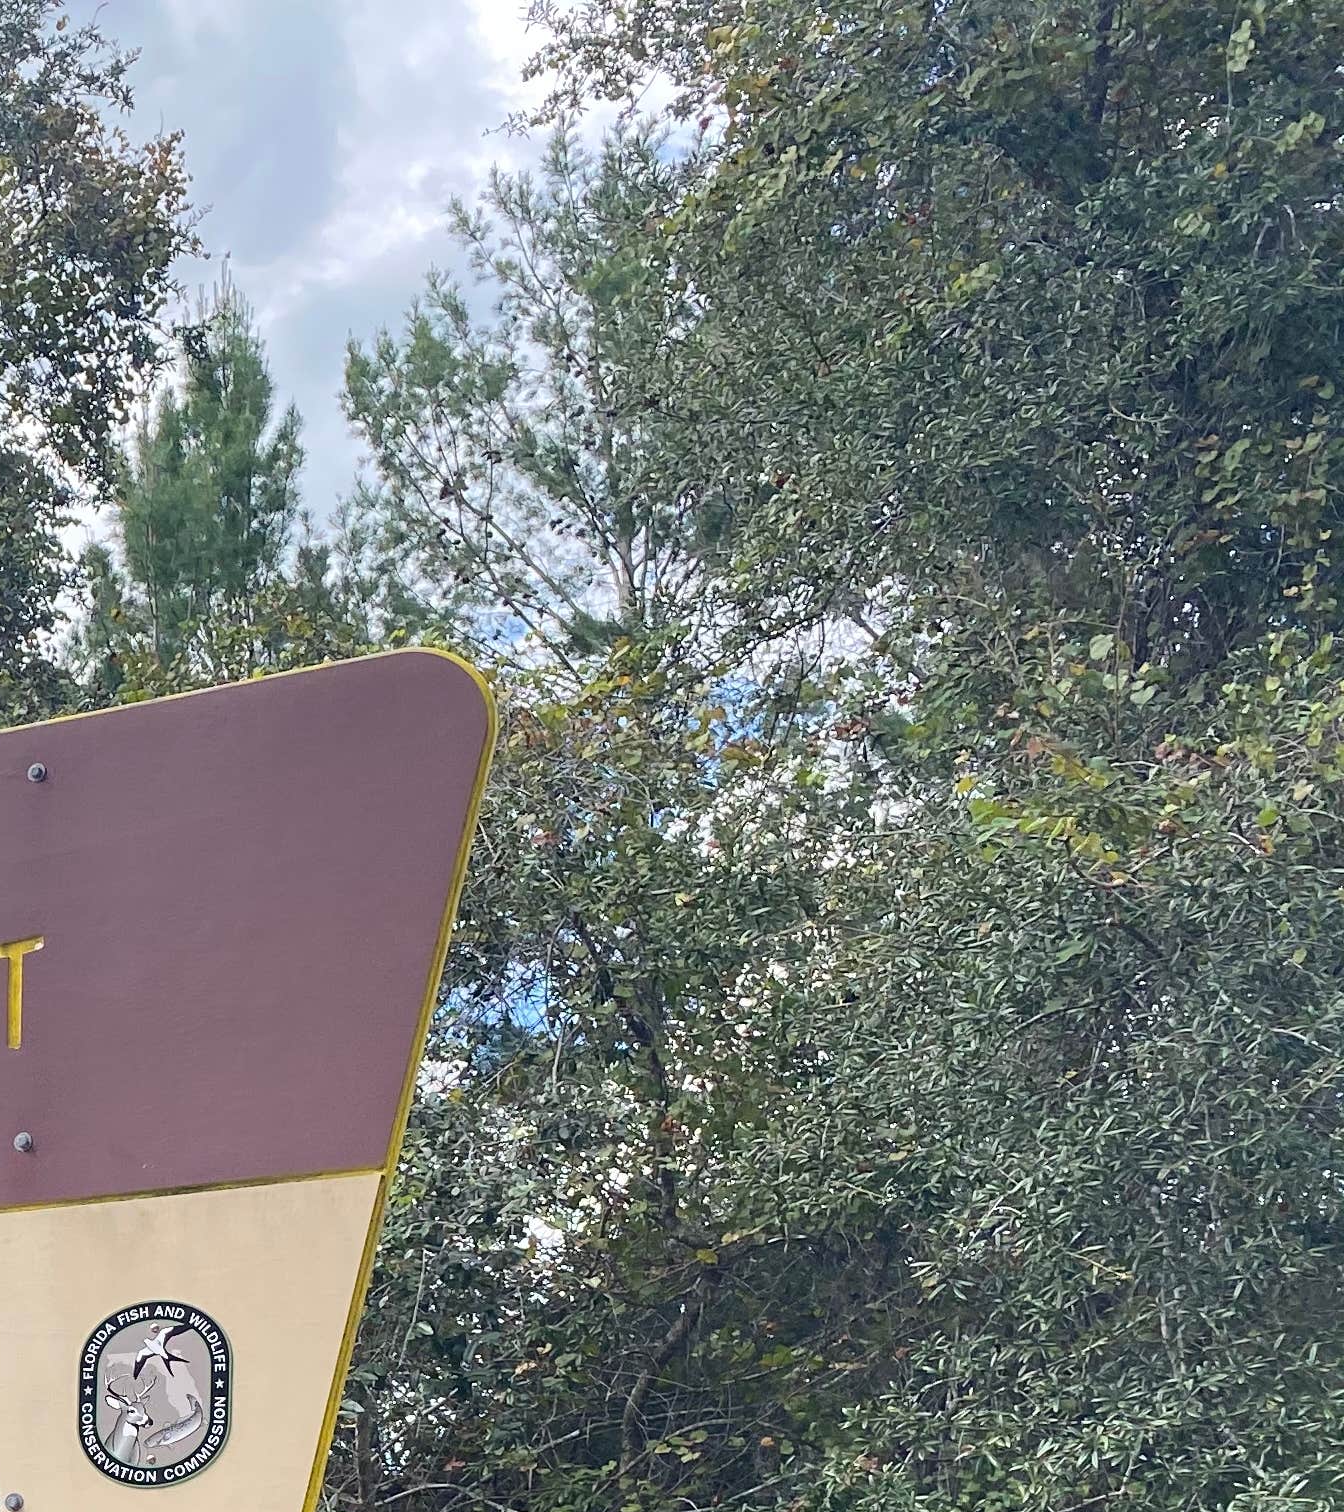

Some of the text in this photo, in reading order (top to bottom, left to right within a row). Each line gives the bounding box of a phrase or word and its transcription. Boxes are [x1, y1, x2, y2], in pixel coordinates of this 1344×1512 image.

[83, 1306, 227, 1379] FLORIDA FISH AND WILDLIFE
[81, 1396, 227, 1483] CONSERVATION COMMISSION
